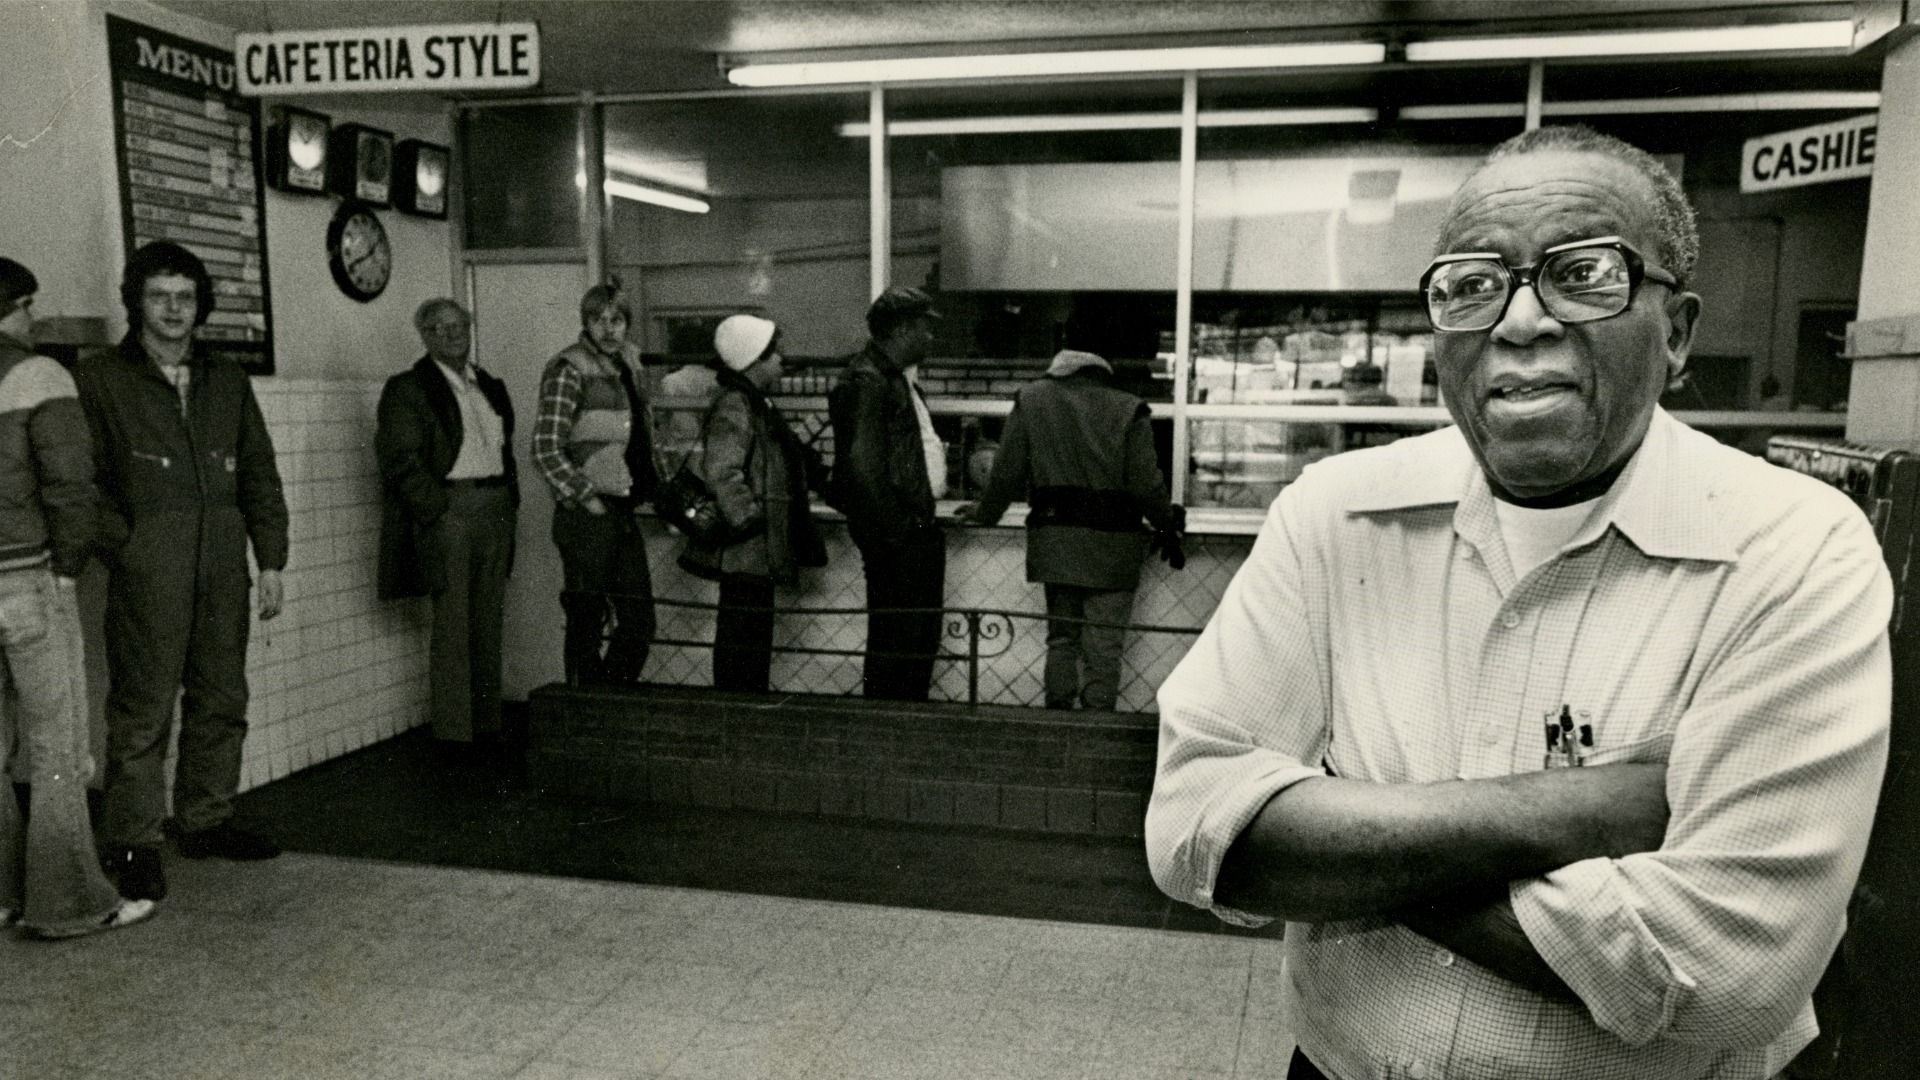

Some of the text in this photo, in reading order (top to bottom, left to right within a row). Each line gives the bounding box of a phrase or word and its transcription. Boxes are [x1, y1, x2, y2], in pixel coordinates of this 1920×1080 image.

[136, 36, 235, 91] MENU
[245, 34, 530, 86] CAFETERIA STYLE
[1752, 126, 1877, 182] CASHIE
